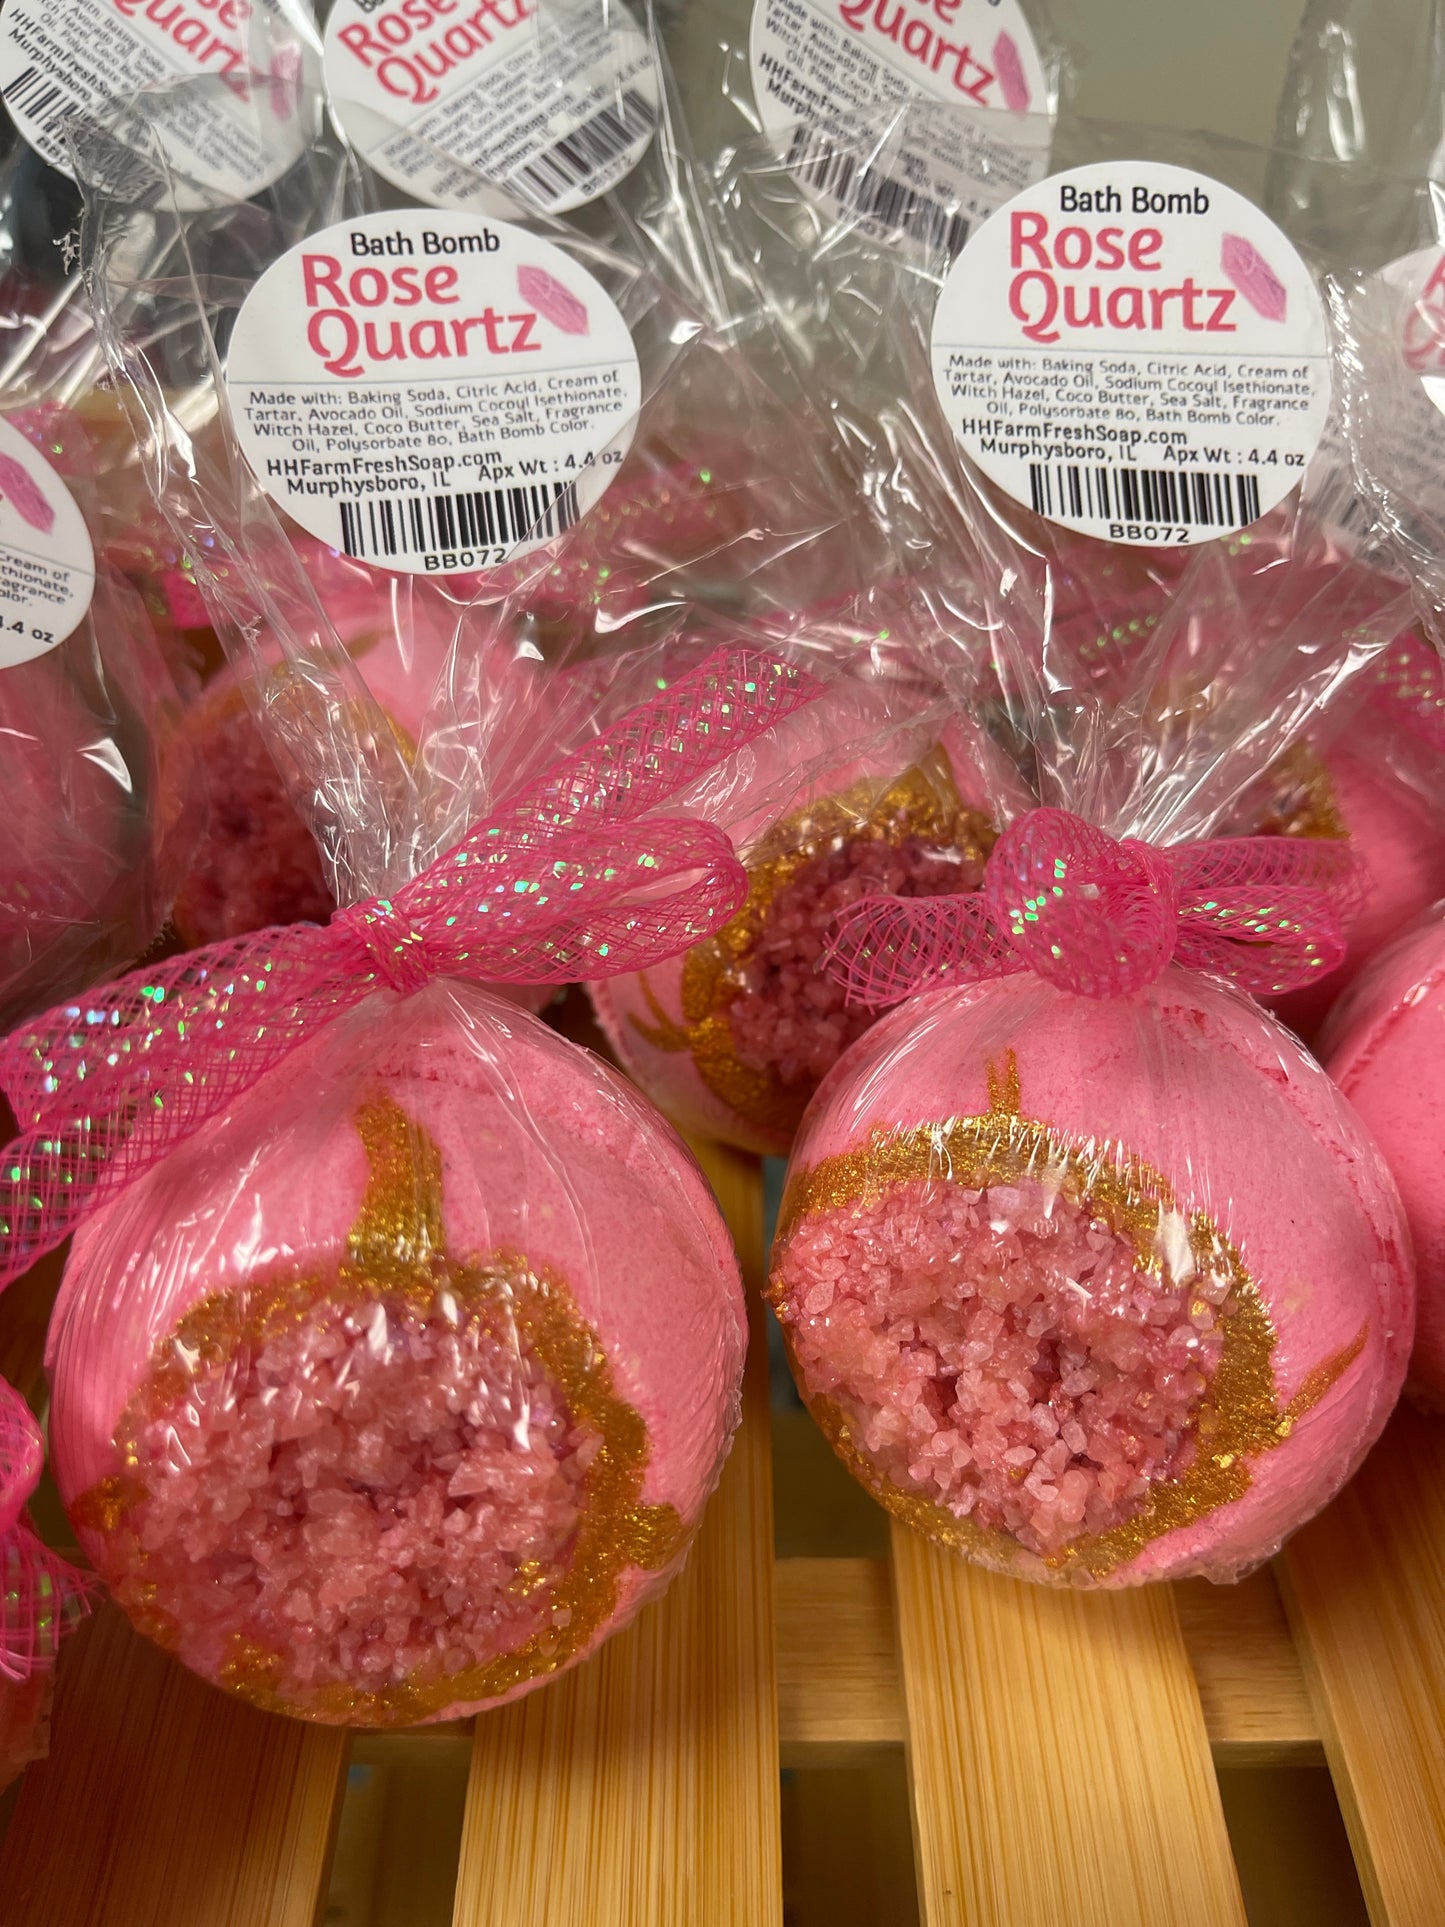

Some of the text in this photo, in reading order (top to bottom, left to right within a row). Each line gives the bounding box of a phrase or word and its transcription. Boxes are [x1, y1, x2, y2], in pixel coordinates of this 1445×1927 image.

[1060, 185, 1210, 214] Bath Bomb
[350, 228, 501, 258] Bath Bomb
[1009, 211, 1164, 271] Rose
[302, 254, 460, 308] Rose
[1008, 269, 1237, 344] Quartz
[307, 307, 542, 378] Quartz
[949, 355, 1309, 379] Made with: Baking Soda, Citric Acid, Cream of
[250, 370, 619, 406] Made with: Baking Soda, Citric Acid, Cream of
[944, 370, 1316, 397] Tartar, Avocado Oil, Sodium Cocoyl Isethionate,
[244, 386, 628, 422] Tartar, Avocado Oil, Sodium Cocoyl Isethionate,
[951, 384, 1310, 412] Witch Hazel, Coco Butter, Sea Salt, Fragrance
[254, 401, 623, 437] Witch Hazel, Coco Butter, Sea Salt, Fragrance
[986, 401, 1280, 426] Oil, Polysorbate 80, Bath Bomb Color.
[292, 420, 595, 454] Oil, Polysorbate 80, Bath Bomb Color.
[962, 418, 1188, 446] HHFarmFreshSoap.com
[267, 451, 503, 477] HHFarmFreshSoap.com
[980, 438, 1137, 463] Murphysboro, IL
[1163, 445, 1199, 466] Apx
[1203, 447, 1232, 463] Wt
[1248, 449, 1278, 465] 4.4
[1284, 453, 1306, 466] oz
[478, 464, 515, 483] Apx
[519, 459, 548, 476] Wt
[564, 451, 596, 469] 4.4
[601, 451, 624, 465] oz
[287, 472, 452, 498] Murphysboro, IL
[1109, 523, 1191, 544] BB072
[424, 548, 508, 571] BB072
[53, 571, 70, 582] of
[0, 614, 54, 644] .4 oz
